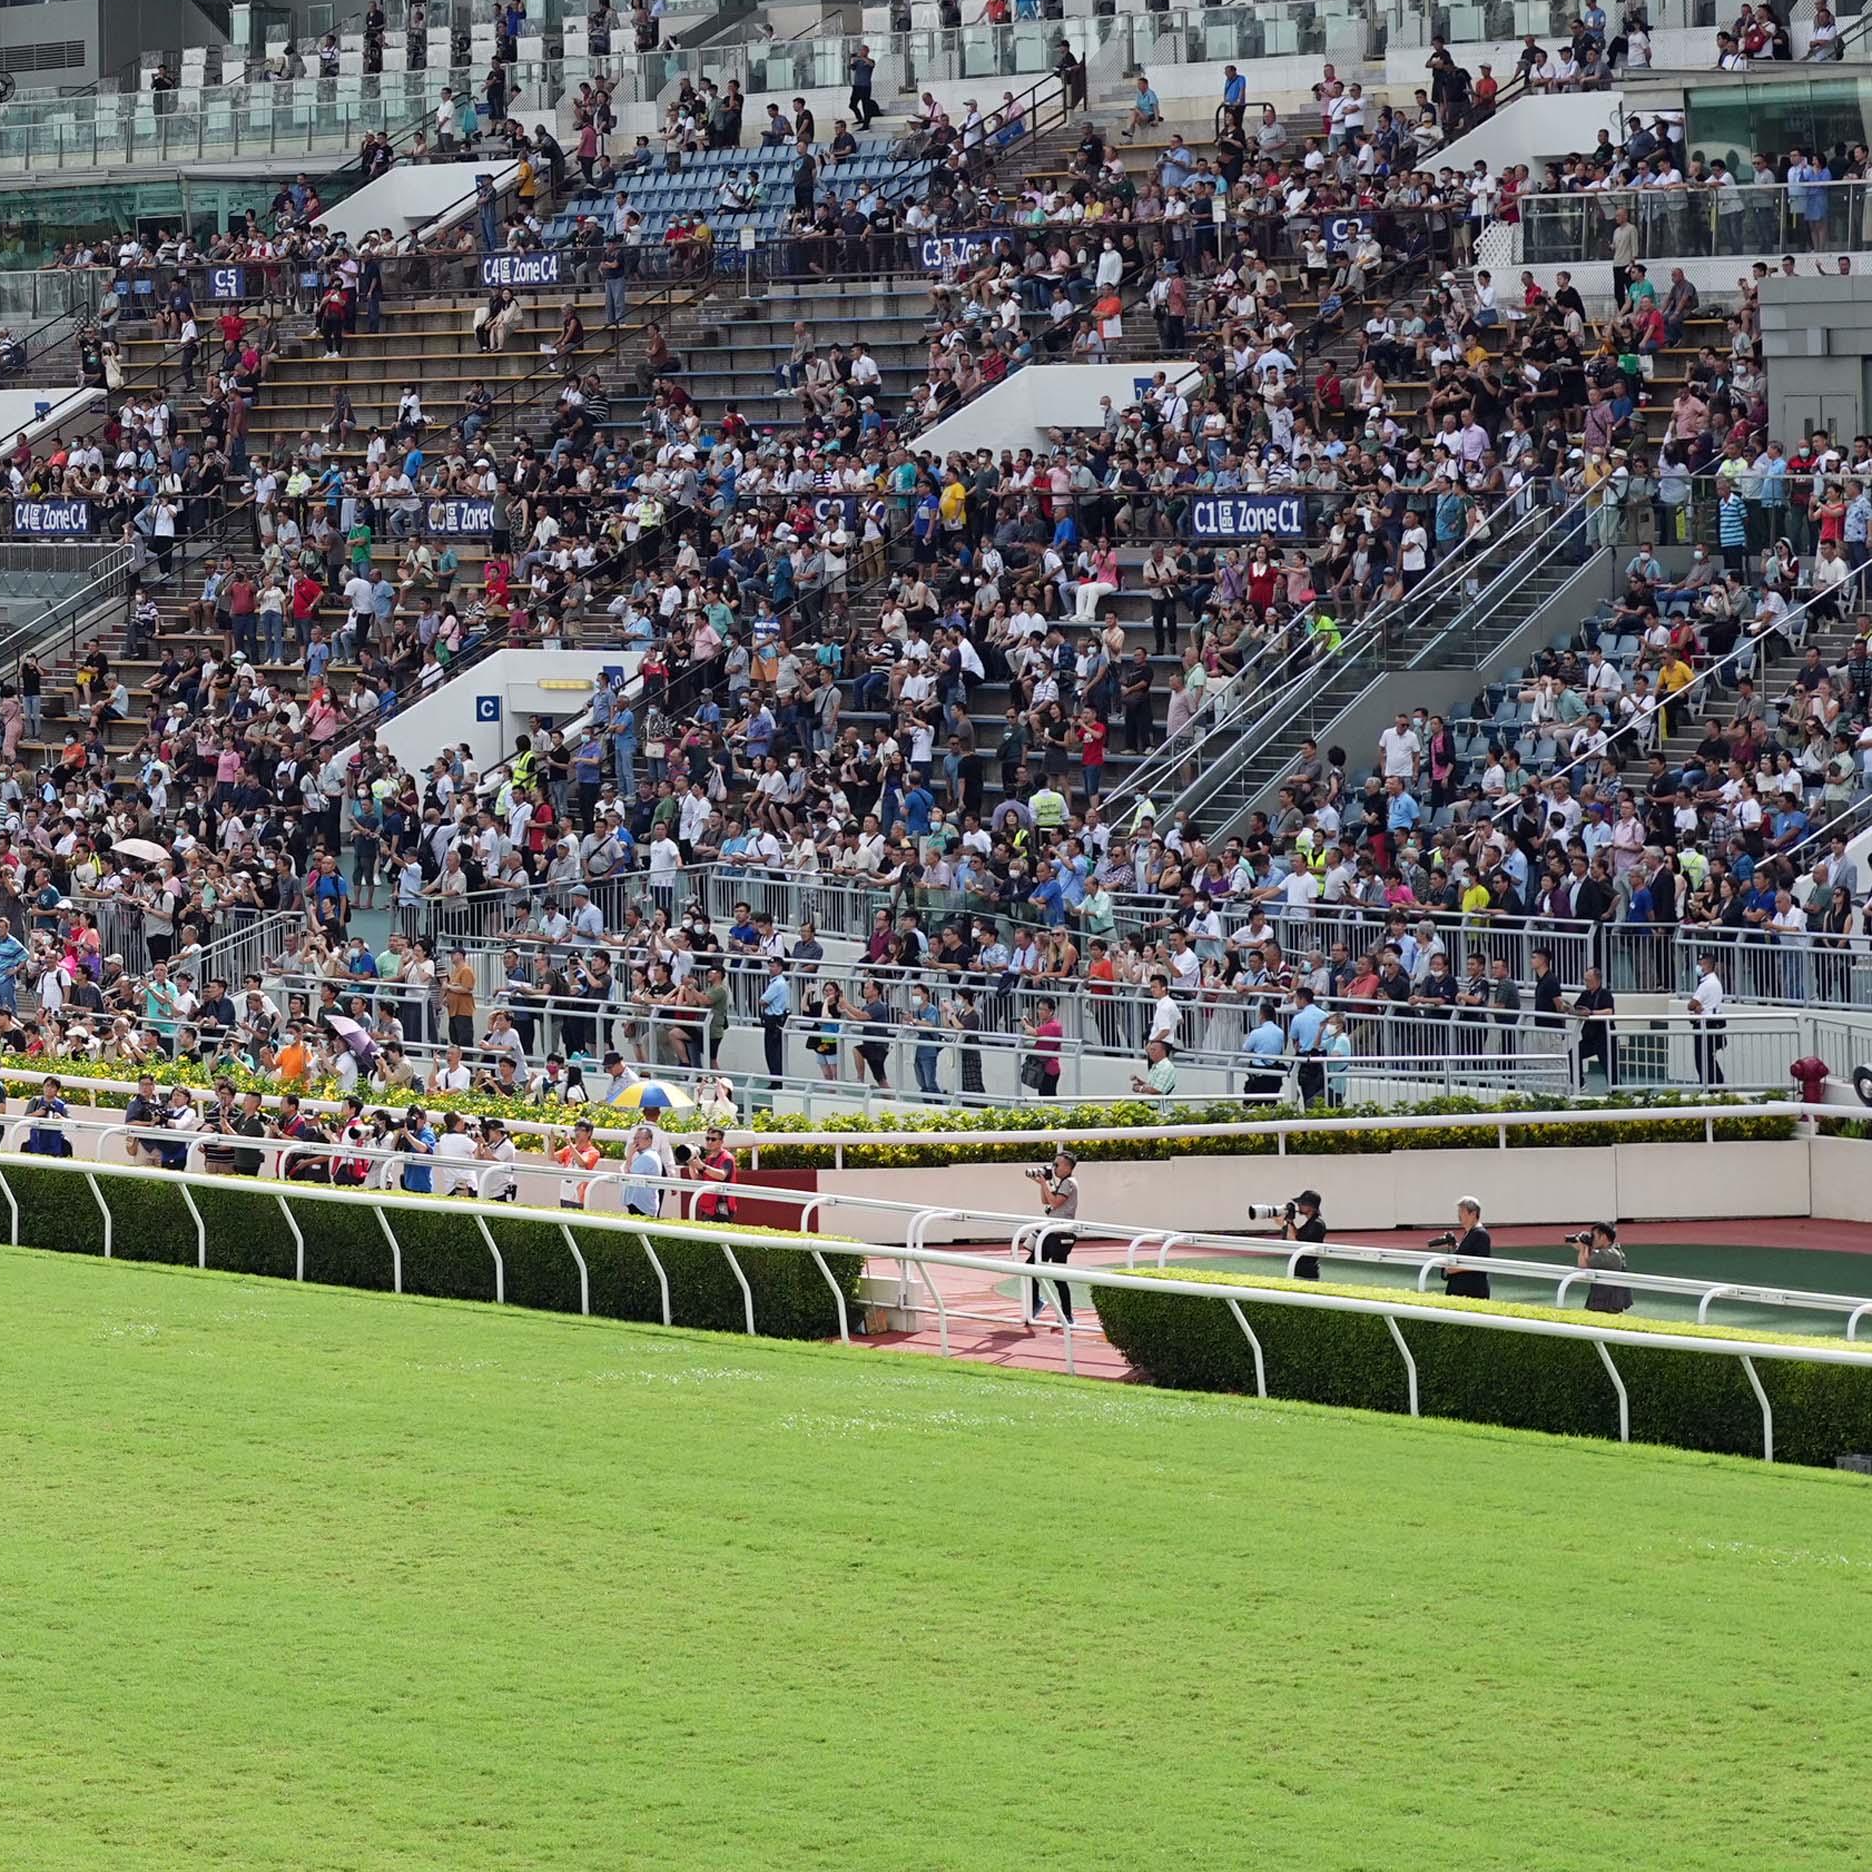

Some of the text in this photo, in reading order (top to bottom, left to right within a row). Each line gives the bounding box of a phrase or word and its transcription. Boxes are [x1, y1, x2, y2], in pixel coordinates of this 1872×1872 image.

[215, 269, 237, 288] C5
[484, 255, 558, 283] C4區 Zone C4
[15, 504, 87, 530] C4區 Zone C4
[461, 503, 488, 530] Zone
[1194, 501, 1302, 533] C1區 Zone C1
[481, 701, 494, 717] C
